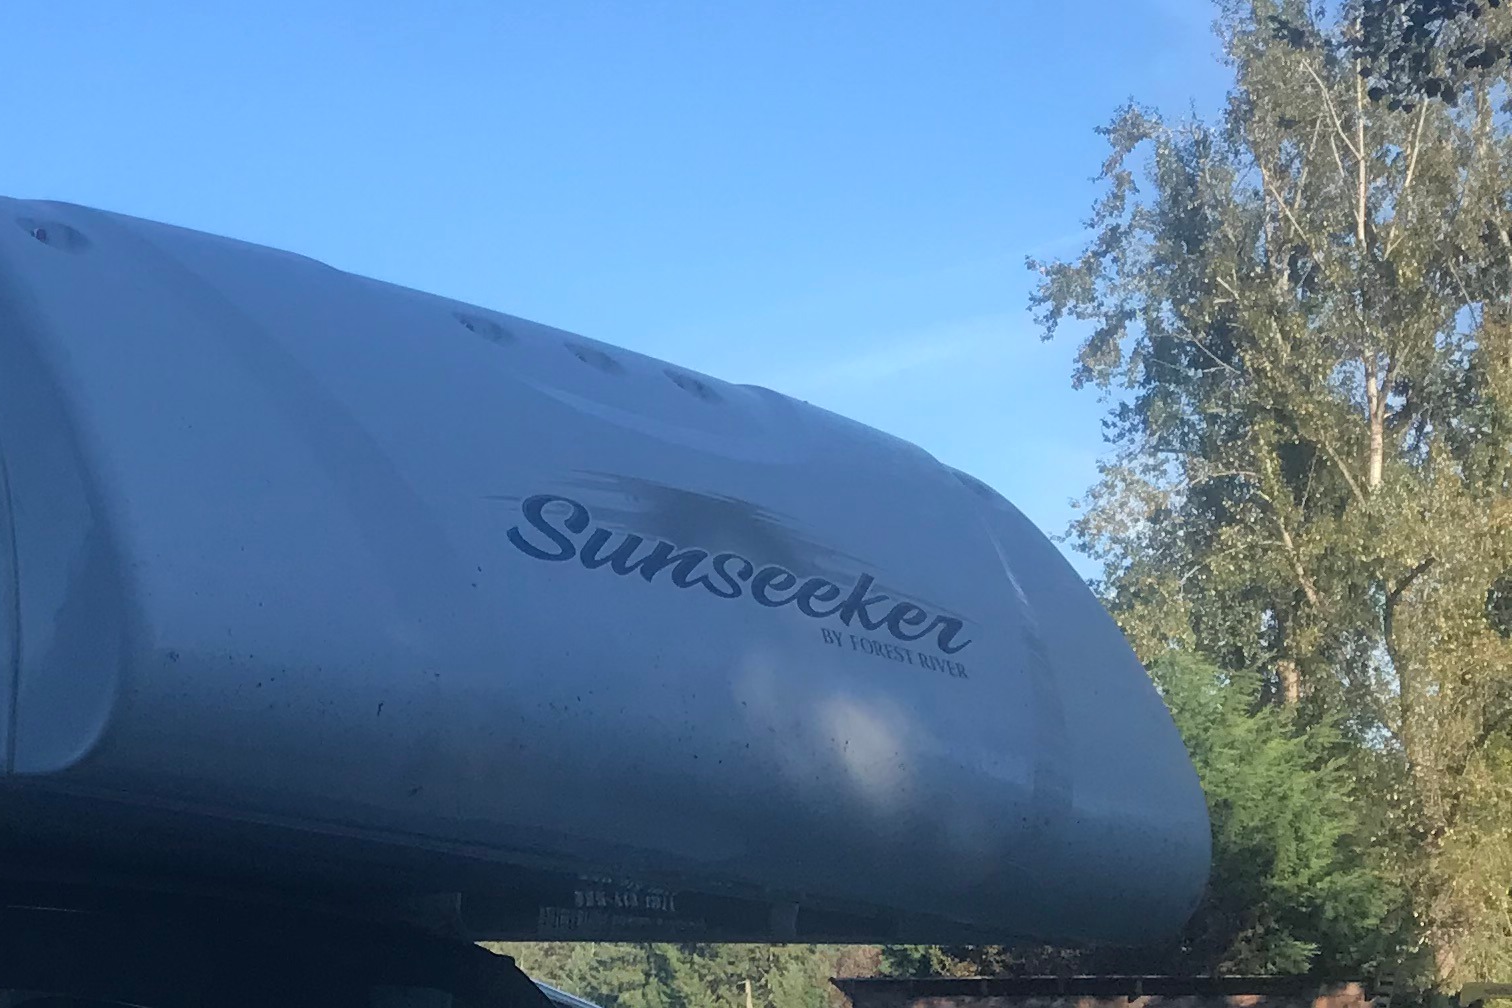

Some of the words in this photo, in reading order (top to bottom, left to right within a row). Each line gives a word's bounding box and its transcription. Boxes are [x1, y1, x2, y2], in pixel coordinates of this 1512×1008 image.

[506, 494, 972, 654] Sunseeker
[821, 628, 842, 647] BY
[849, 634, 913, 665] FOREST
[918, 652, 968, 679] RIVER
